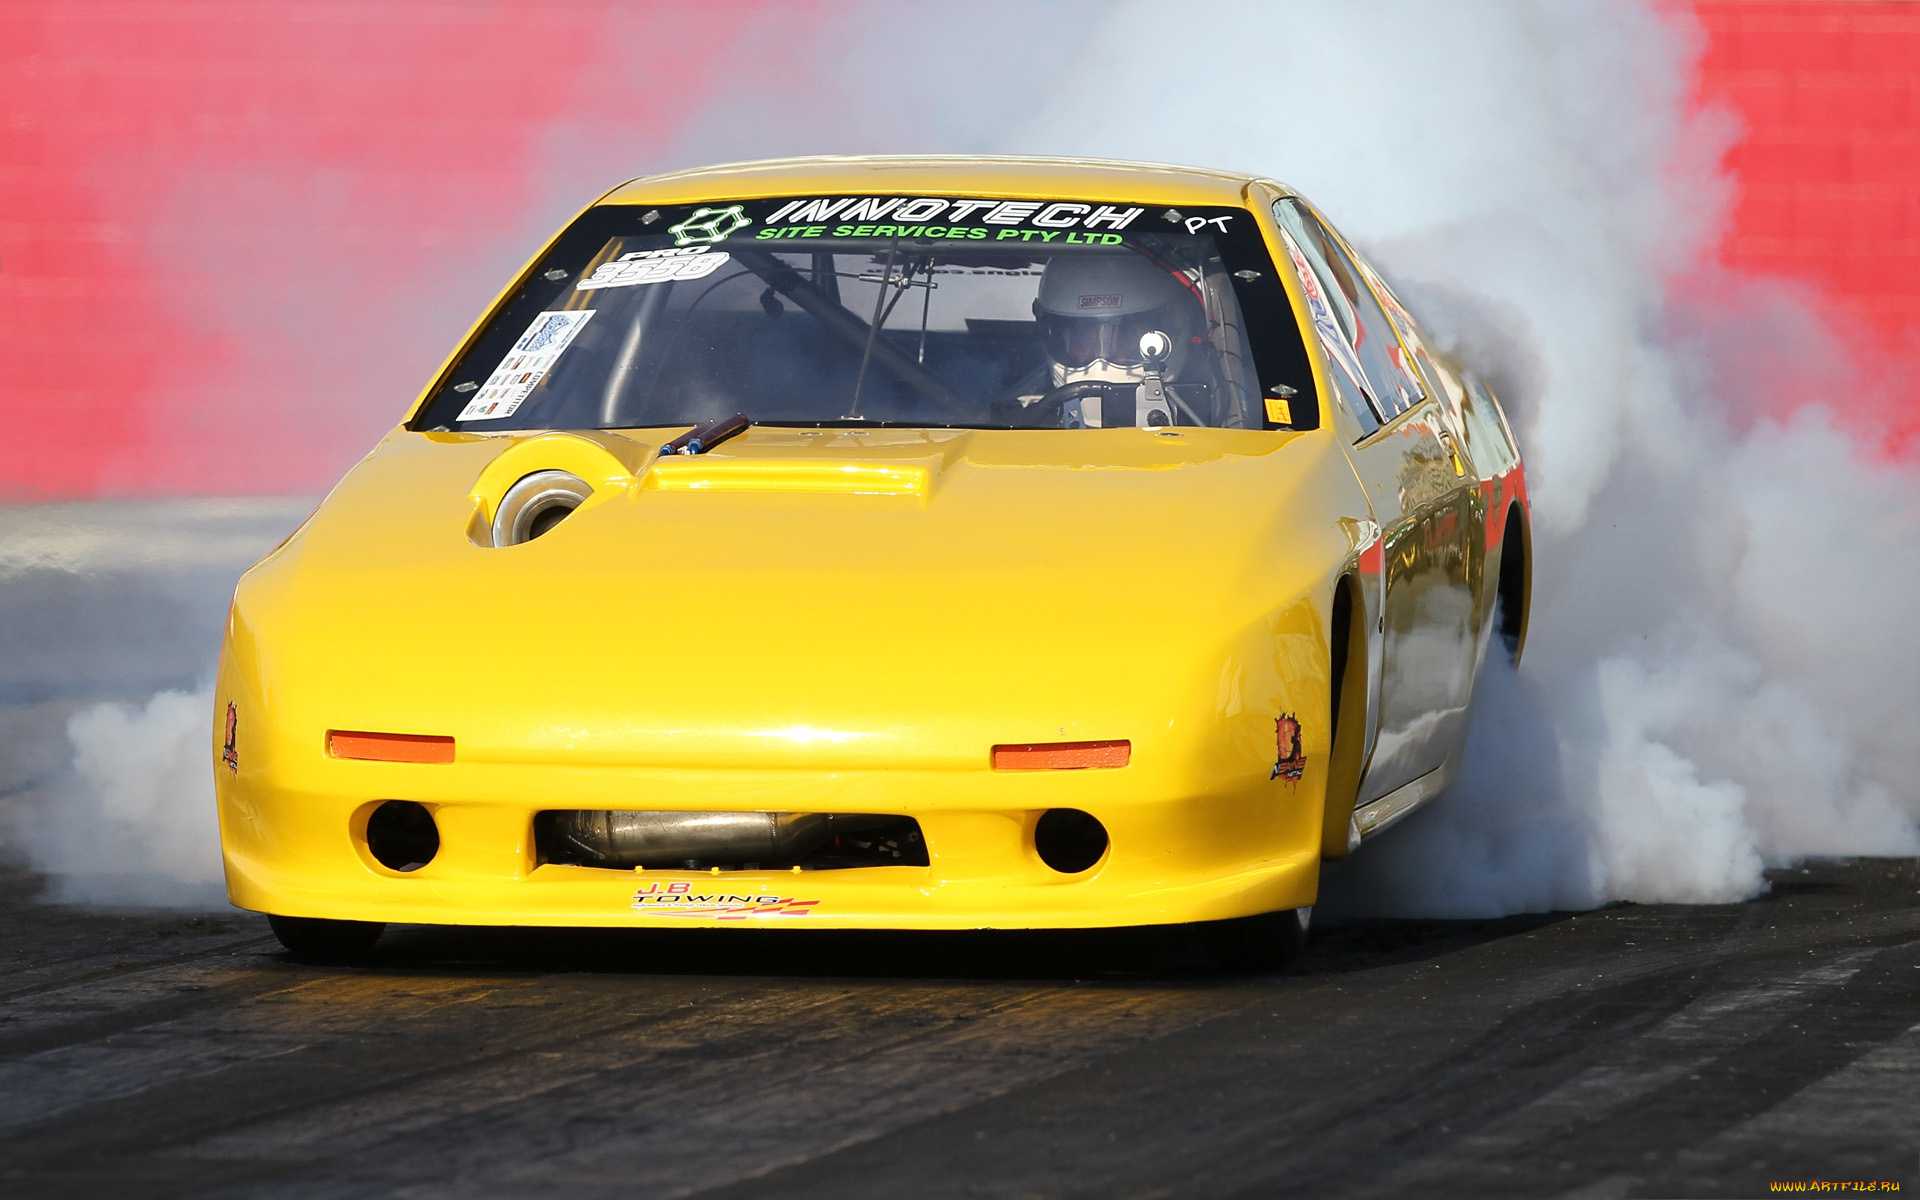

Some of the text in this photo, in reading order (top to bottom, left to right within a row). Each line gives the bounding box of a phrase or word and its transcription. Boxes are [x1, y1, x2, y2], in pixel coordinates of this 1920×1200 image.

[765, 198, 1144, 230] INNOTECH
[1184, 215, 1233, 235] PT
[755, 224, 1124, 247] SITE SERVICES PTY LTD
[617, 245, 712, 262] PRO
[576, 252, 730, 291] 3558
[1080, 296, 1119, 308] SIMPSON
[505, 370, 544, 415] COMPETITOR
[637, 882, 691, 895] J.B
[632, 895, 780, 904] TOWING
